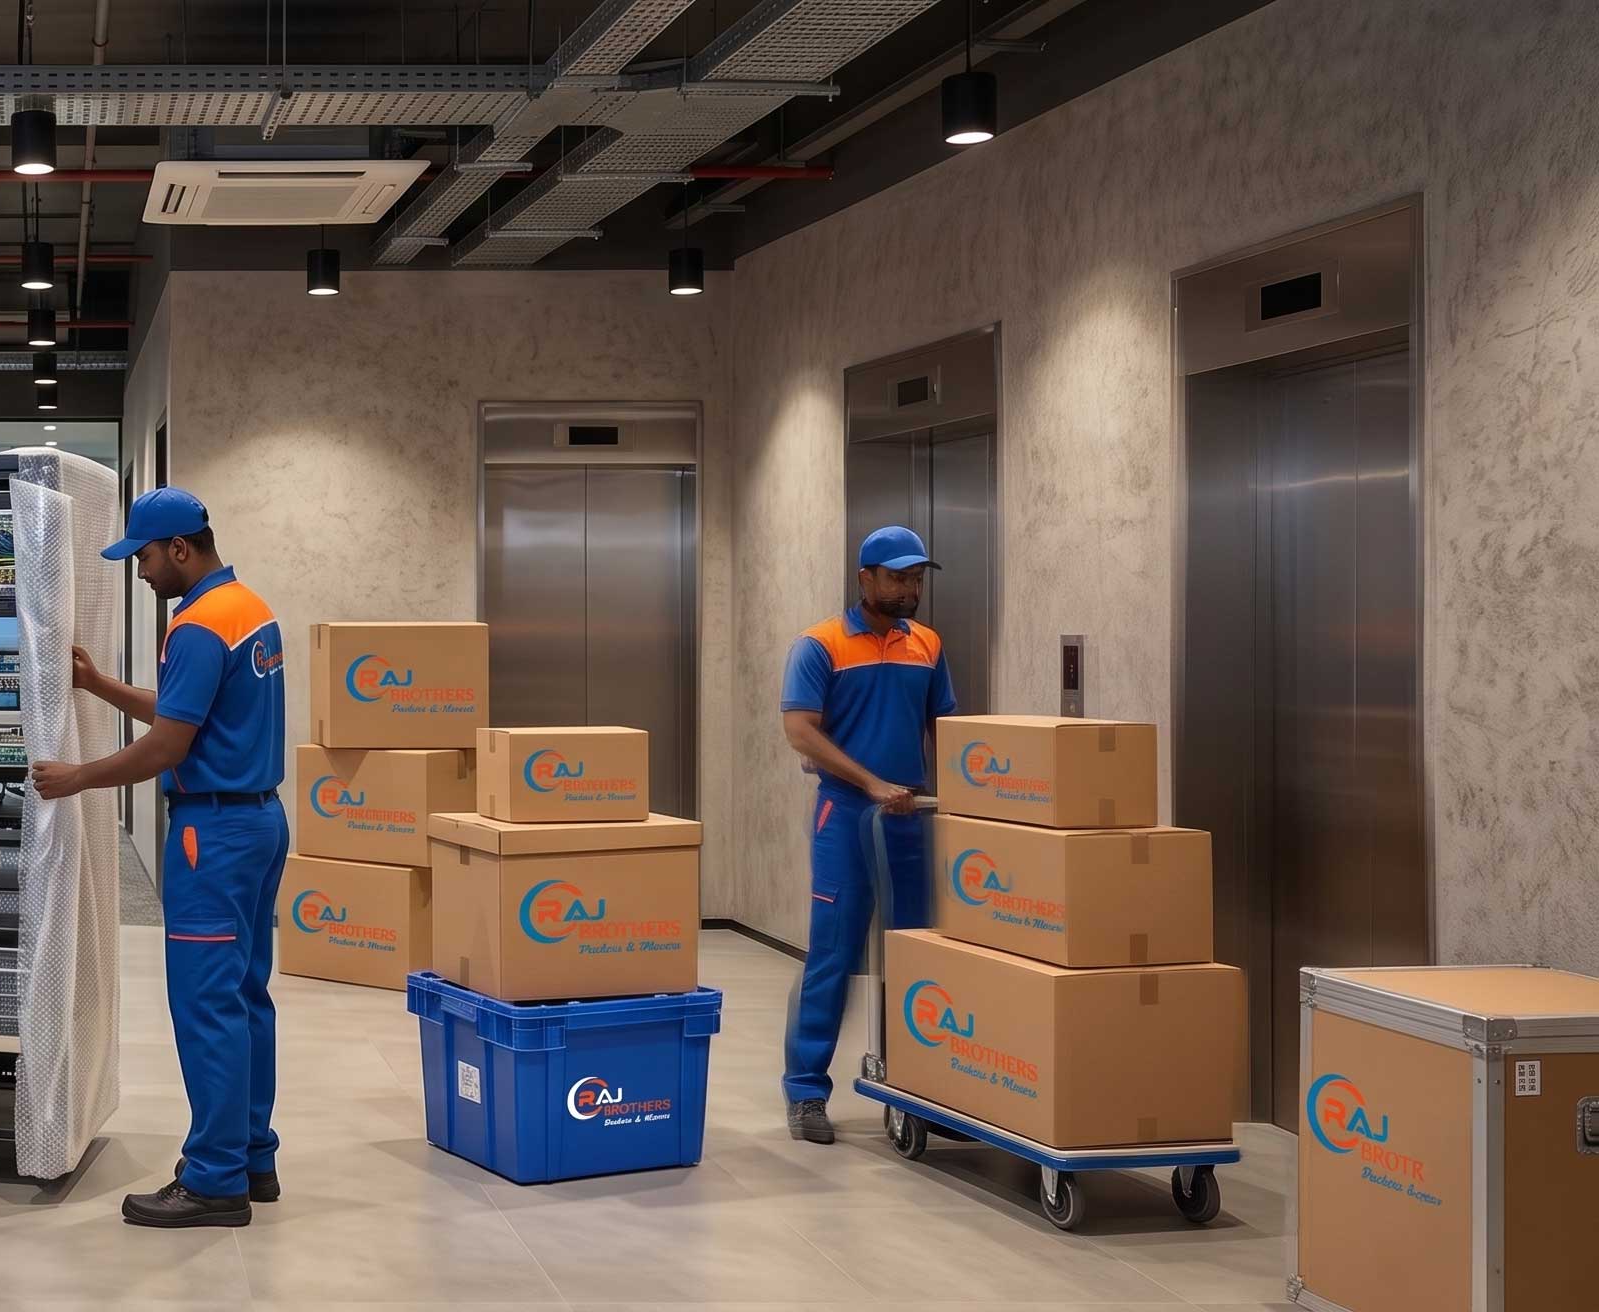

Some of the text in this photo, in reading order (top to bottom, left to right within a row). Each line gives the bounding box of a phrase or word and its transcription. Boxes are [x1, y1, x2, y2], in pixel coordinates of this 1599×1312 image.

[359, 669, 413, 688] RAJ
[535, 760, 584, 779] RAJ
[321, 788, 365, 806] RAJ
[303, 903, 347, 922] RAJ
[537, 898, 606, 924] RAJ
[328, 923, 397, 942] BROTHERS
[579, 920, 681, 939] BROTHERS
[917, 998, 974, 1038] RAJ
[951, 1037, 1038, 1082] BROTHERS
[578, 1088, 623, 1107] RAJ
[603, 1099, 671, 1117] BROTHERS
[1324, 1097, 1388, 1143] RAJ
